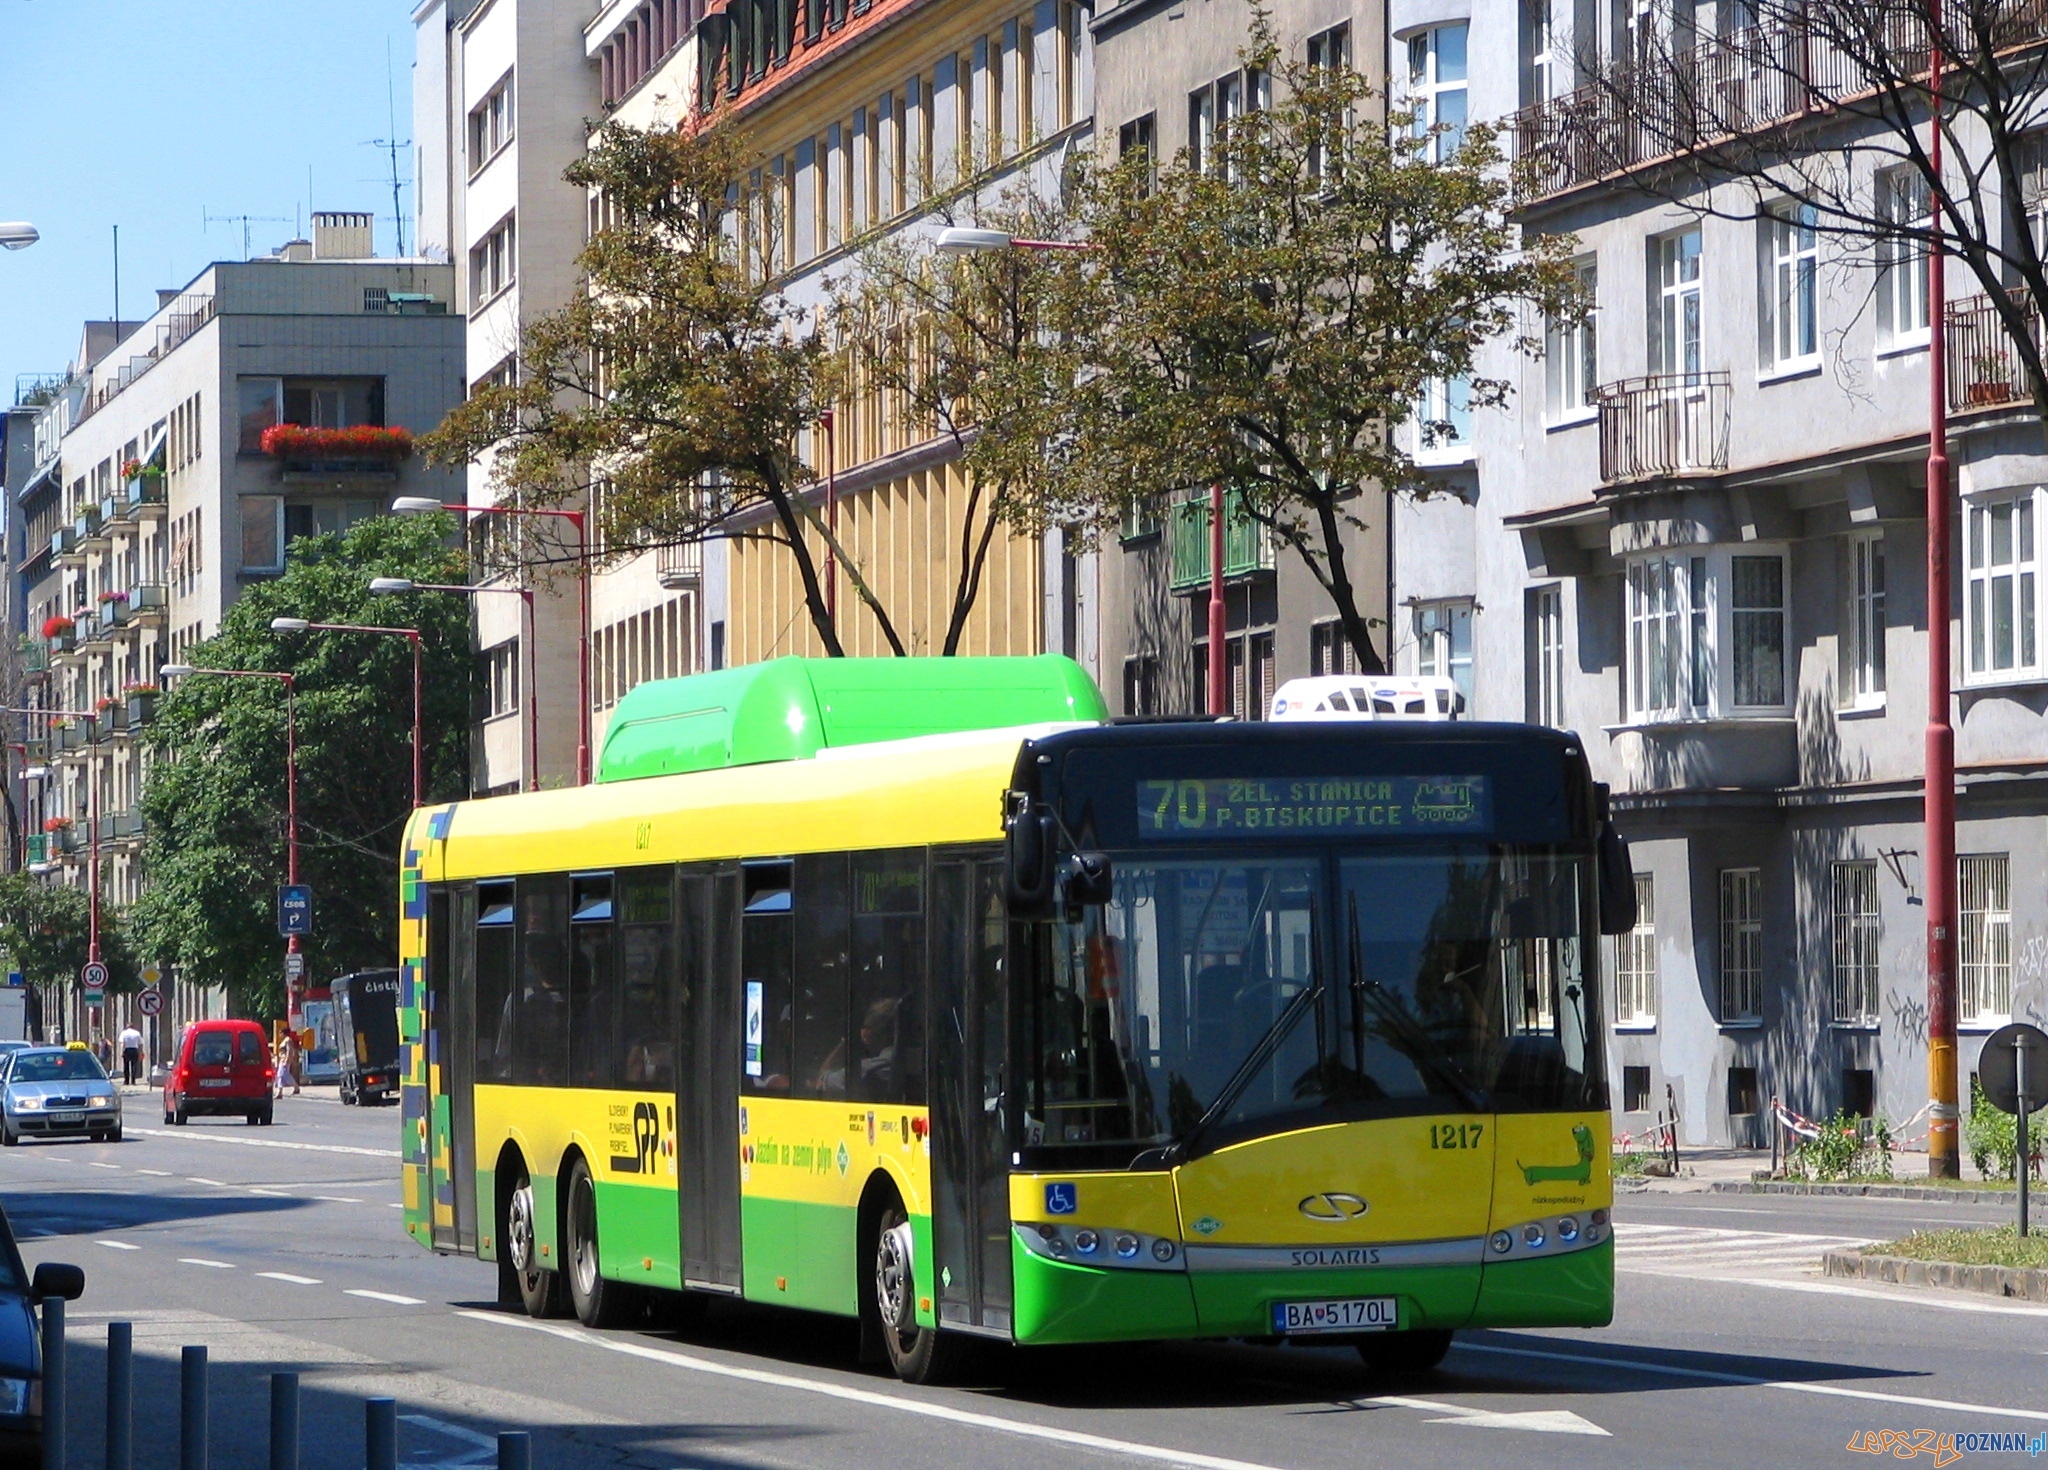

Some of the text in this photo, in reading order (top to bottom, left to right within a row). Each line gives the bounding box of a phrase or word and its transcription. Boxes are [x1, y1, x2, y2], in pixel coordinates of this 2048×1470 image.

[1290, 781, 1393, 803] STANICA
[1146, 779, 1208, 829] 70
[88, 969, 102, 982] 50
[1429, 1124, 1484, 1150] 1217
[1291, 1249, 1381, 1266] SOLARIS
